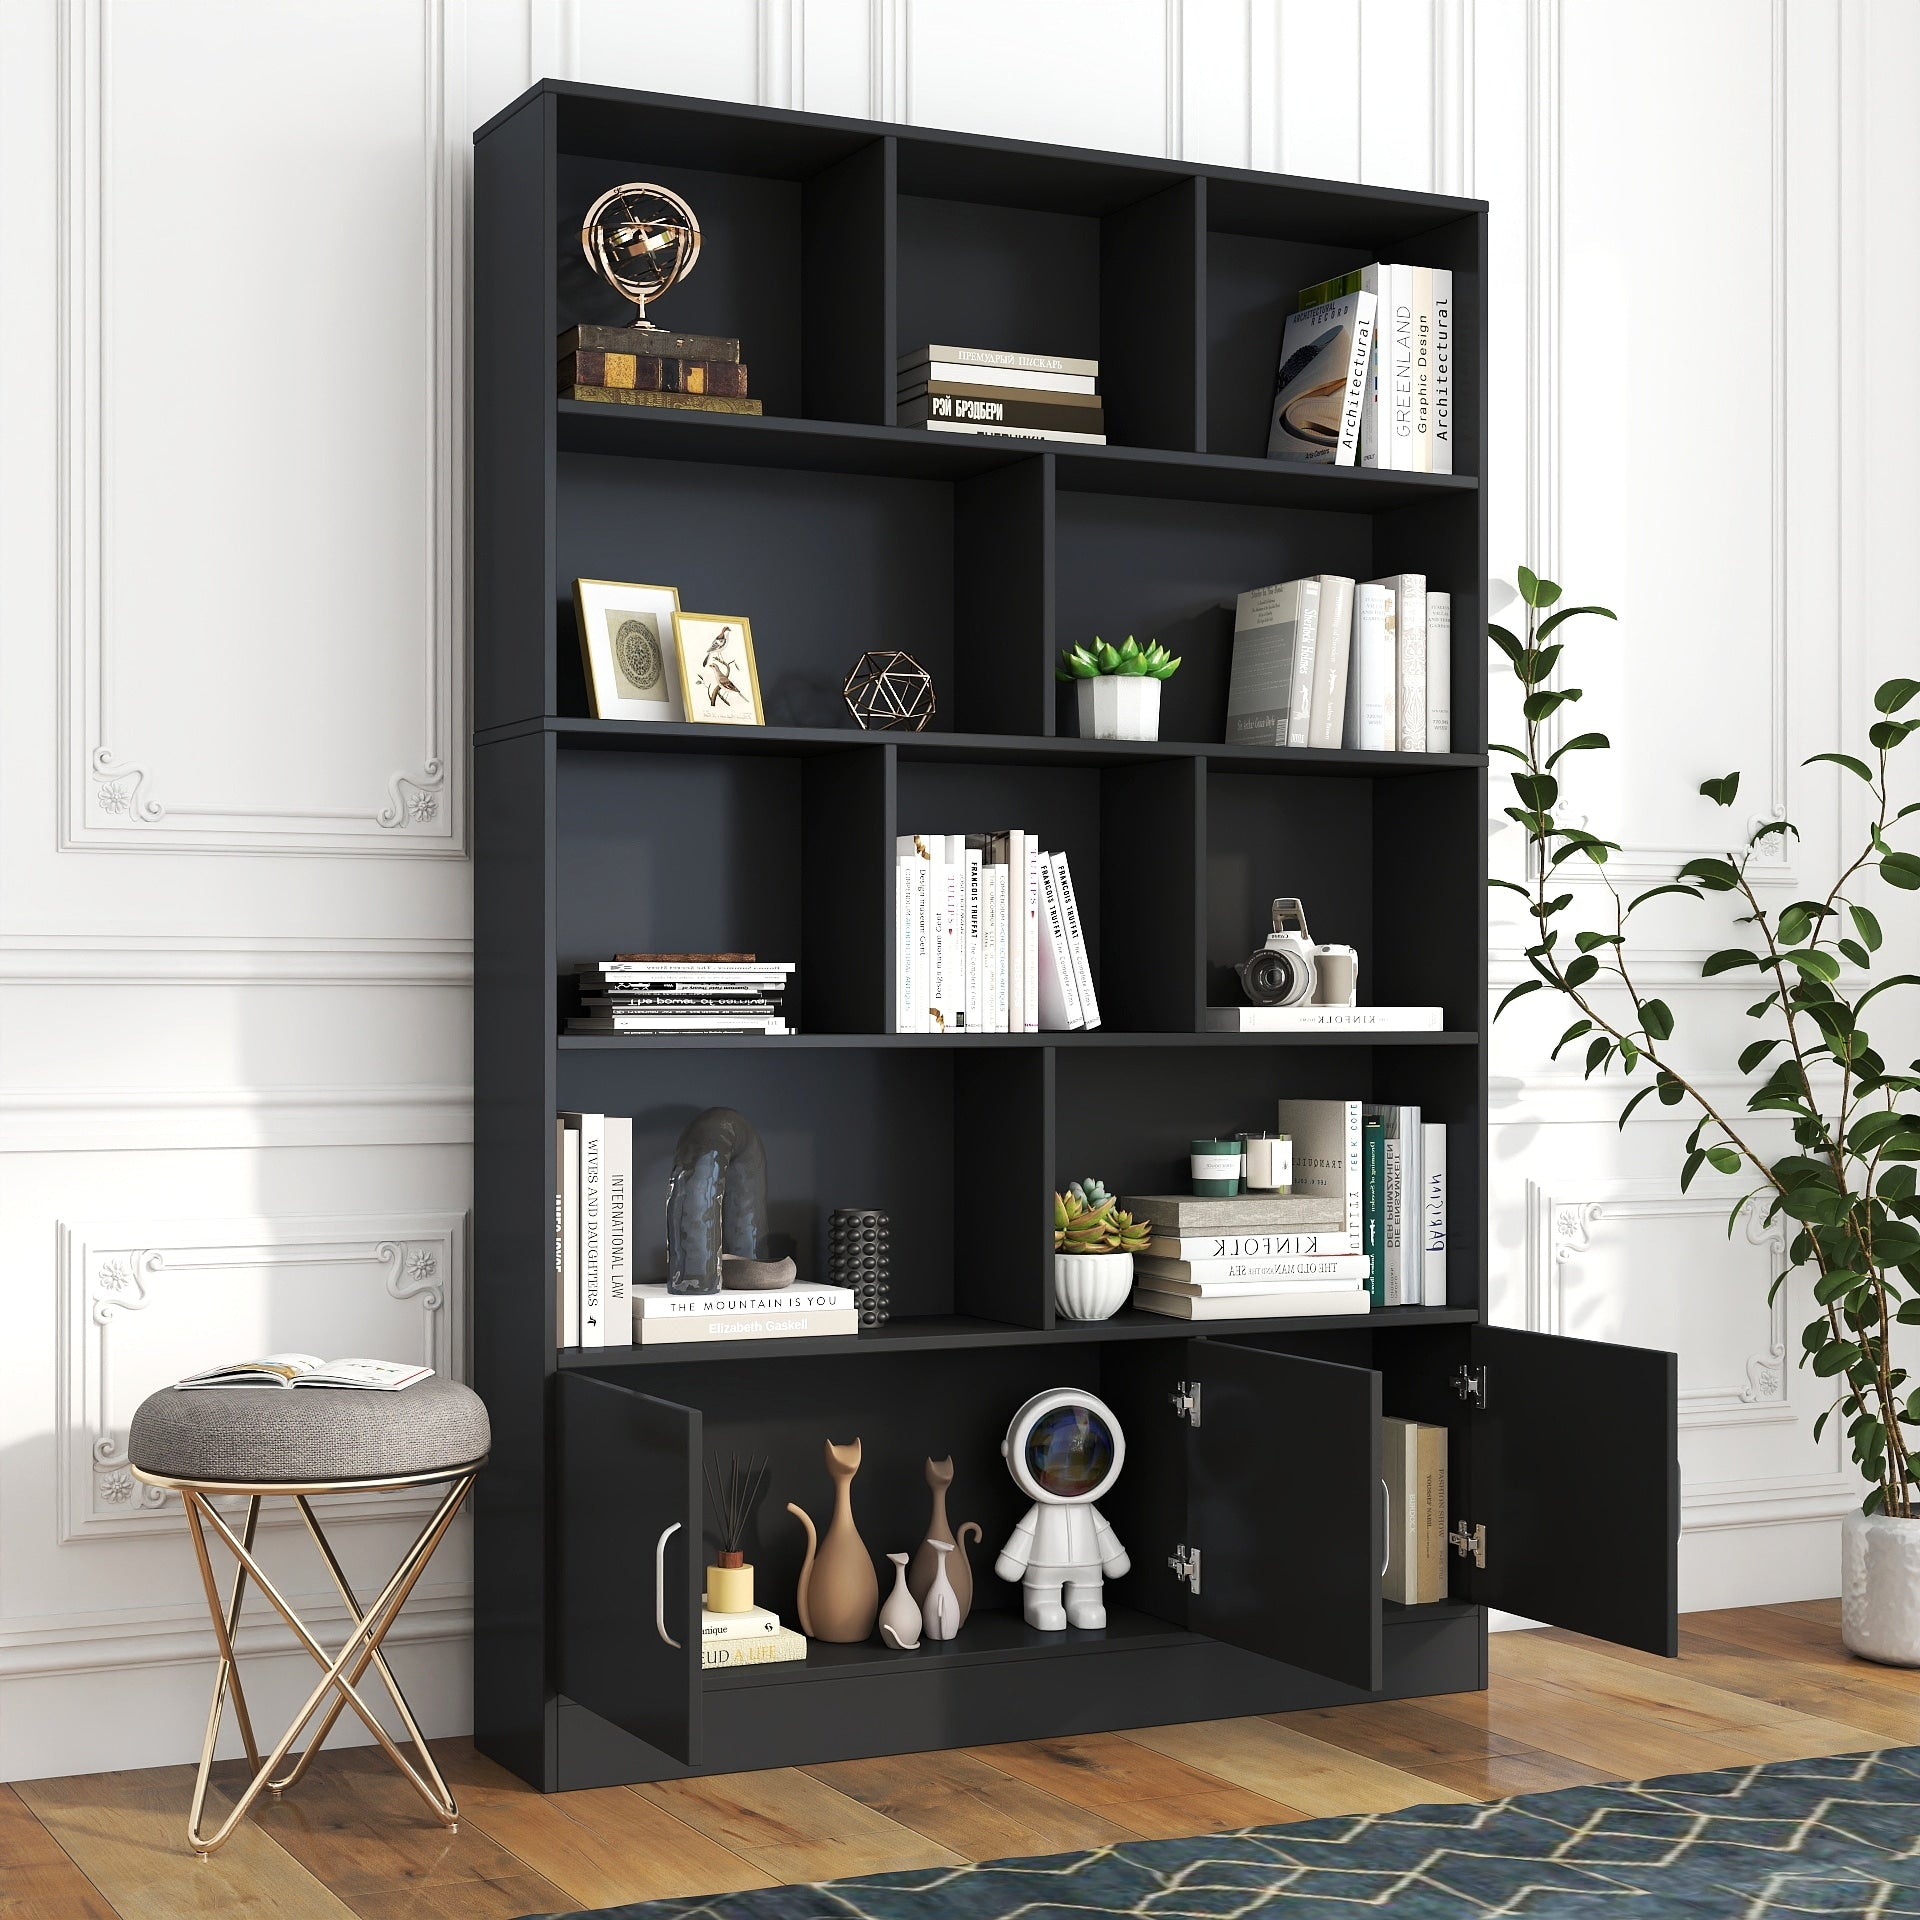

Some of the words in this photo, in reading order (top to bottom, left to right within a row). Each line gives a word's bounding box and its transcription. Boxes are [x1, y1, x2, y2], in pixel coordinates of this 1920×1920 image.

[1293, 302, 1336, 323] ARCHITECTURAL
[1311, 306, 1348, 326] RECORD
[1418, 315, 1430, 367] Design
[958, 351, 1015, 365] ПРЕМУДРЫЙ
[1397, 306, 1411, 437] GREENLAND
[1436, 298, 1448, 441] Architectural
[1342, 320, 1370, 449] Architectural
[932, 395, 952, 417] РЭЙ
[955, 399, 1003, 421] БРЭДБЕРИ
[1418, 374, 1430, 434] Graphic
[1301, 608, 1317, 643] Sherlock
[1299, 645, 1313, 675] Holmes
[918, 869, 927, 898] Design
[1058, 865, 1072, 904] FRANCOIS
[1041, 865, 1055, 904] FRANCOIS
[1048, 905, 1062, 939] TRUFFAT
[1064, 905, 1079, 939] TRUFFAT
[919, 935, 927, 956] Gent
[935, 971, 943, 999] Design
[1076, 955, 1088, 988] Complete
[588, 1139, 599, 1183] WIVES
[588, 1187, 599, 1217] AND
[611, 1174, 624, 1270] INTERNATIONAL
[588, 1221, 599, 1307] DAUGHTERS
[611, 1275, 624, 1299] LAW
[671, 1302, 695, 1312] THE
[704, 1299, 782, 1311] MOUNTAIN
[789, 1298, 801, 1307] IS
[807, 1296, 837, 1306] YOU
[708, 1320, 763, 1334] Elizabeth
[765, 1318, 808, 1331] Gaskell
[702, 1626, 728, 1636] anique
[702, 1649, 730, 1665] EUD
[734, 1647, 744, 1661] A
[748, 1645, 776, 1661] LIFE
